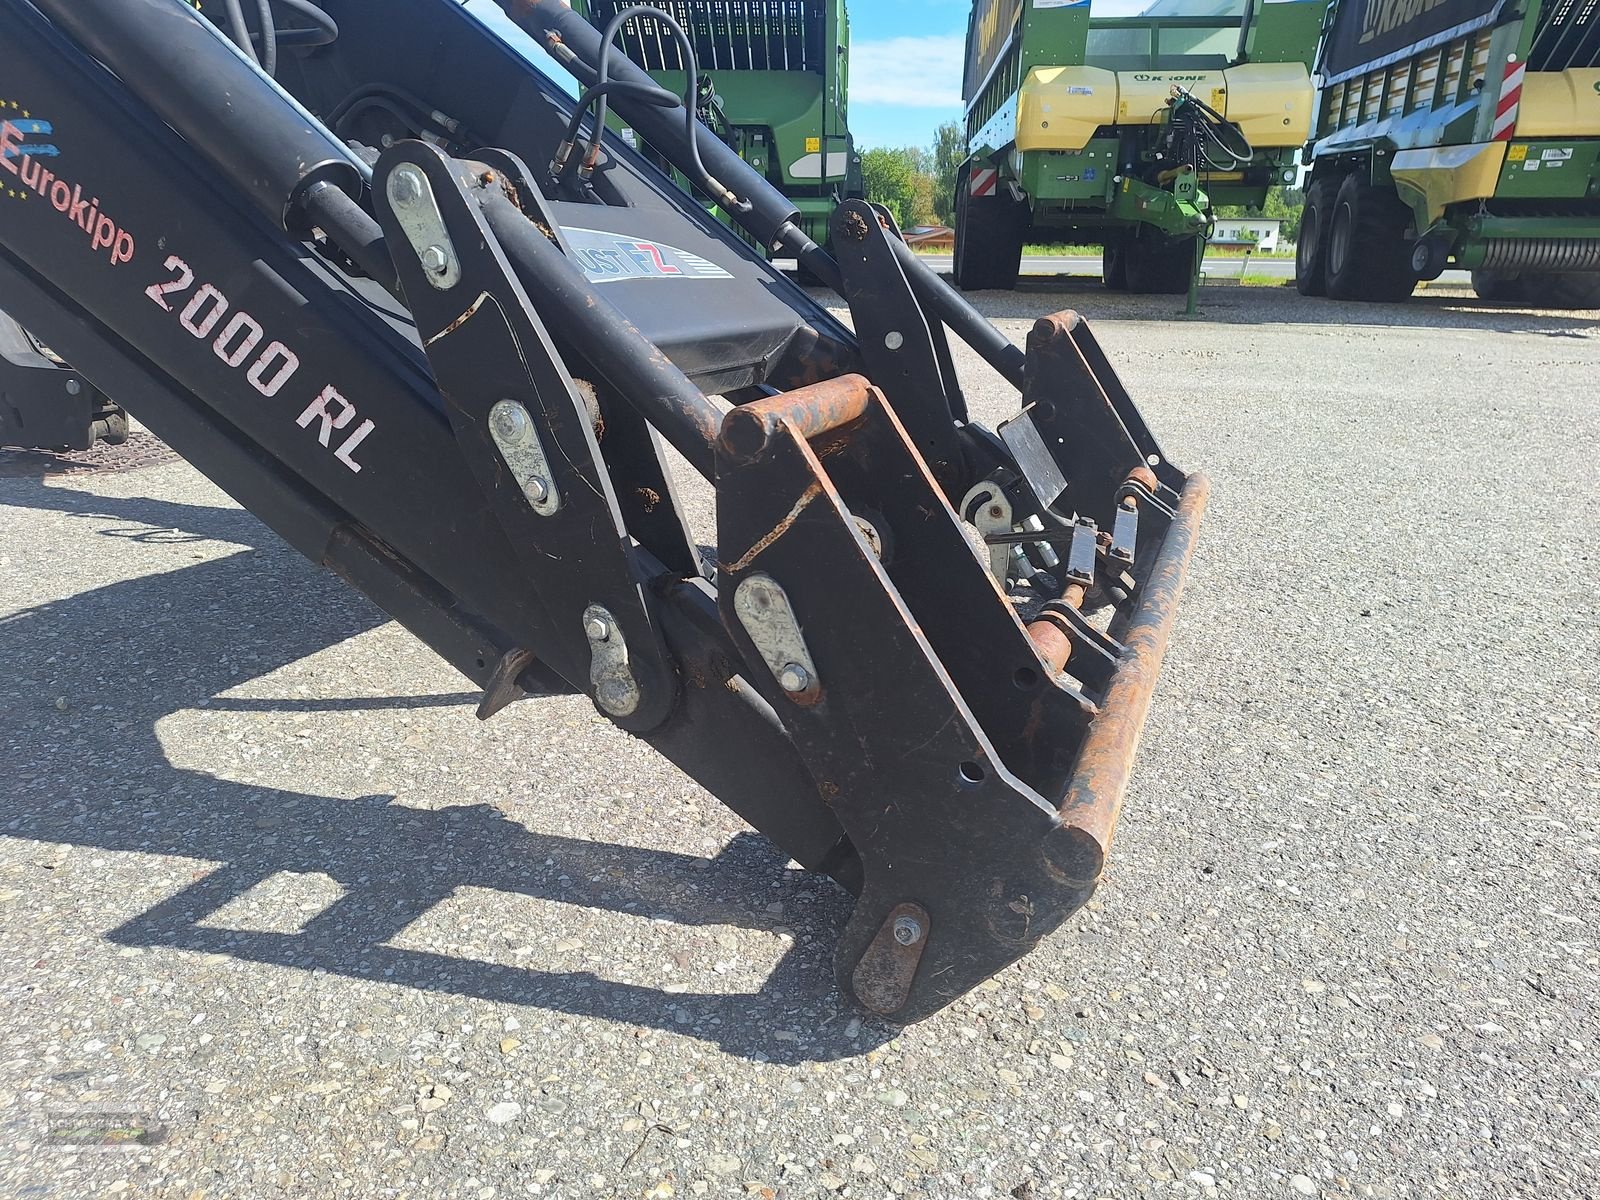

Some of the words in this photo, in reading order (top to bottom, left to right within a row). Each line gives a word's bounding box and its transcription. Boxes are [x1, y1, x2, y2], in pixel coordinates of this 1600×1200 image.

[0, 120, 134, 265] Eurokipp
[145, 255, 300, 397] 2000
[296, 384, 375, 473] RL
[613, 241, 682, 275] FZ
